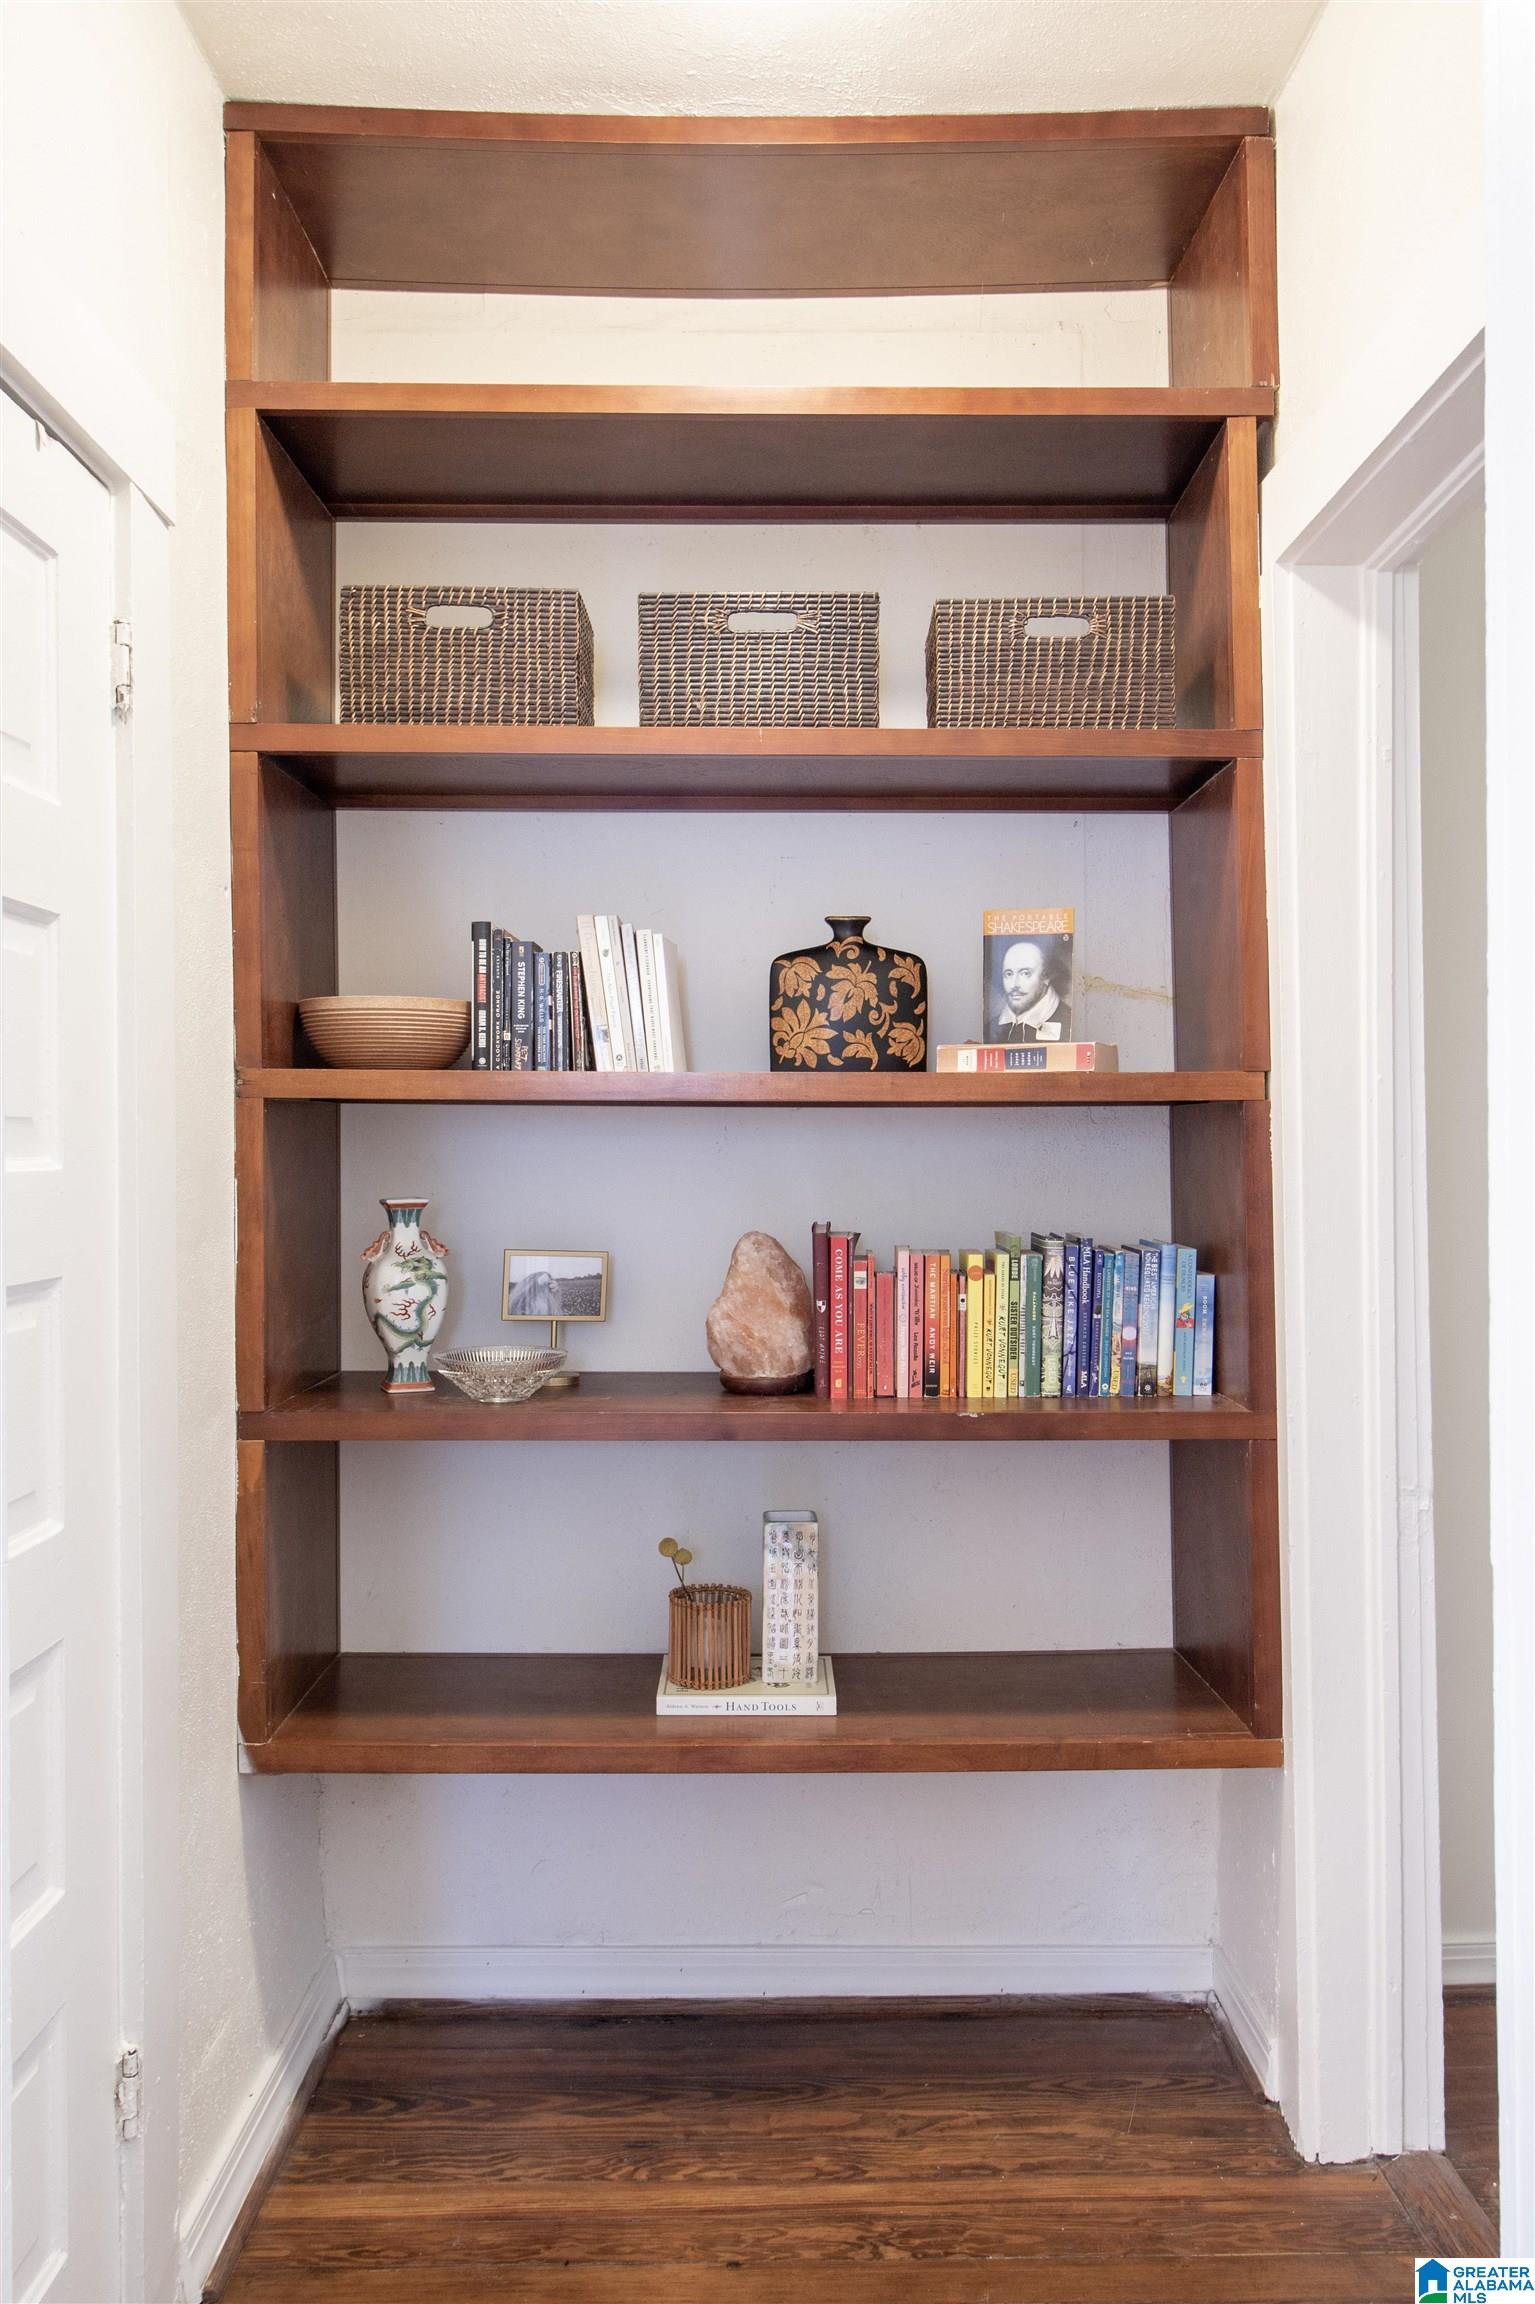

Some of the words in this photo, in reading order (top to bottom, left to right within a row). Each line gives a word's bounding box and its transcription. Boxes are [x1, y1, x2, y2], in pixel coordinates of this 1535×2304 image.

[988, 920, 1070, 934] SHAKESPEARE
[517, 961, 526, 998] STEPHEN
[517, 999, 526, 1020] KING
[835, 1248, 843, 1281] COME
[1083, 1246, 1092, 1265] MLA
[929, 1262, 937, 1279] THE
[1011, 1259, 1019, 1280] LORDE
[1067, 1256, 1075, 1285] BLUE
[835, 1285, 843, 1300] AS
[1081, 1266, 1091, 1305] Handbook
[929, 1281, 937, 1319] MARTIAN
[835, 1304, 843, 1327] YOU
[1010, 1301, 1018, 1325] SISTER
[998, 1316, 1006, 1337] KURT
[835, 1330, 843, 1354] ARE
[856, 1322, 865, 1356] FEVER
[985, 1348, 993, 1385] VONNEGUT
[997, 1338, 1006, 1380] VONNEGUT
[1080, 1370, 1088, 1389] MLA
[1111, 1369, 1119, 1391] USED
[725, 1701, 759, 1711] HAND
[761, 1701, 798, 1711] TOOLS
